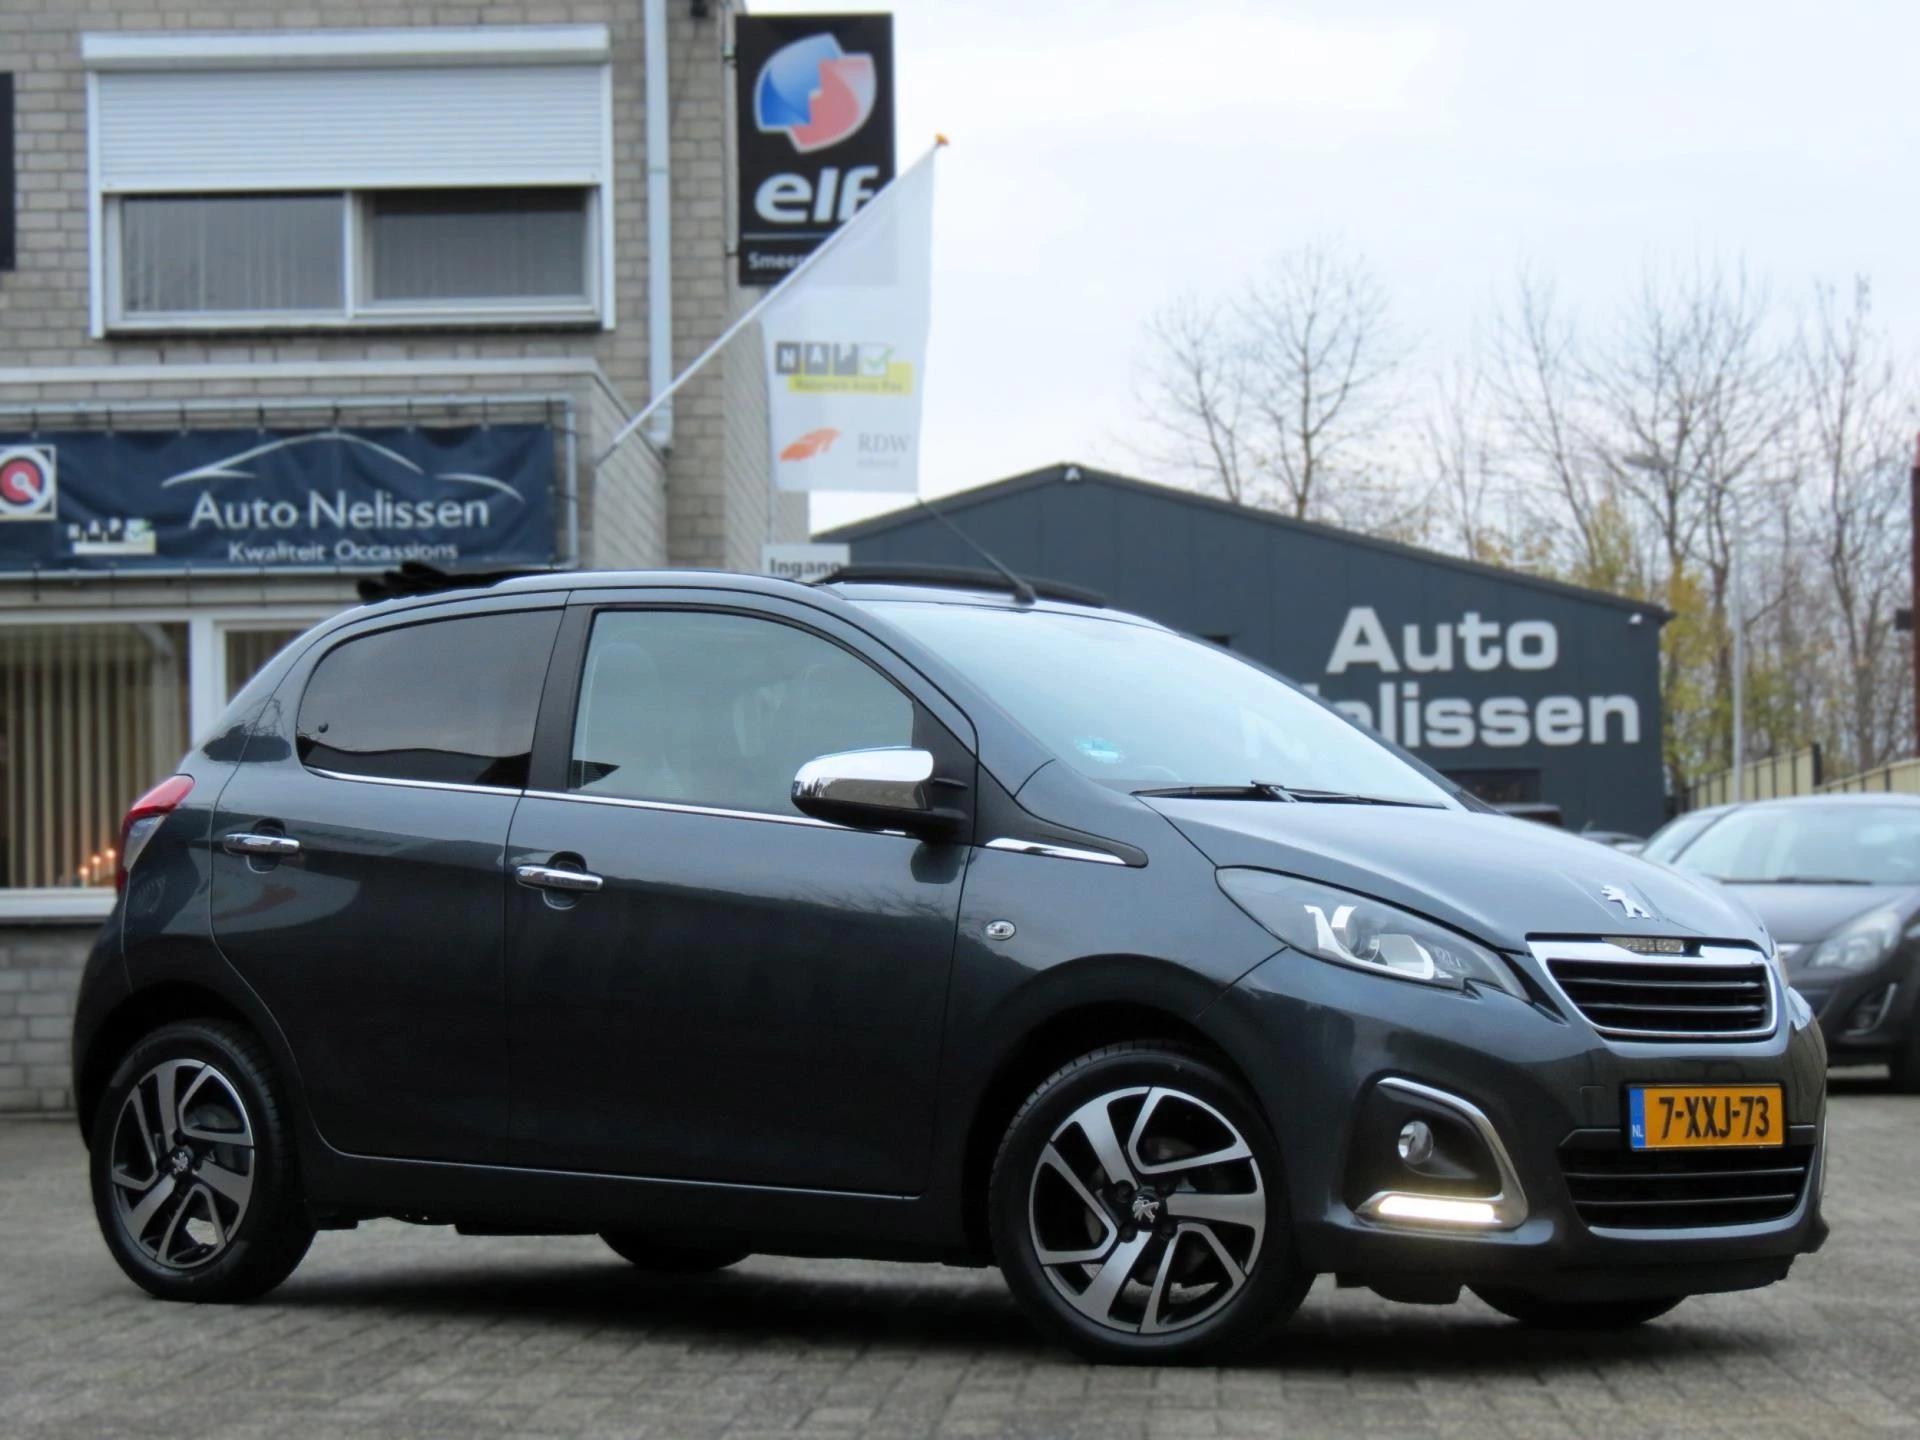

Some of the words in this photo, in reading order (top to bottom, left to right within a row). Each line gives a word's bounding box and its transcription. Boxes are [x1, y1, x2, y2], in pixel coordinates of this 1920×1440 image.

[754, 166, 879, 223] elf
[857, 433, 911, 453] RDW
[188, 489, 299, 530] Auto
[309, 488, 489, 530] Nelissen
[227, 541, 326, 562] Kwaliteit
[334, 539, 458, 562] Occassions
[1326, 606, 1558, 673] Auto
[1301, 682, 1640, 748] lissen
[1631, 1124, 1644, 1138] NL
[1658, 1095, 1770, 1139] 7-XXJ-73
